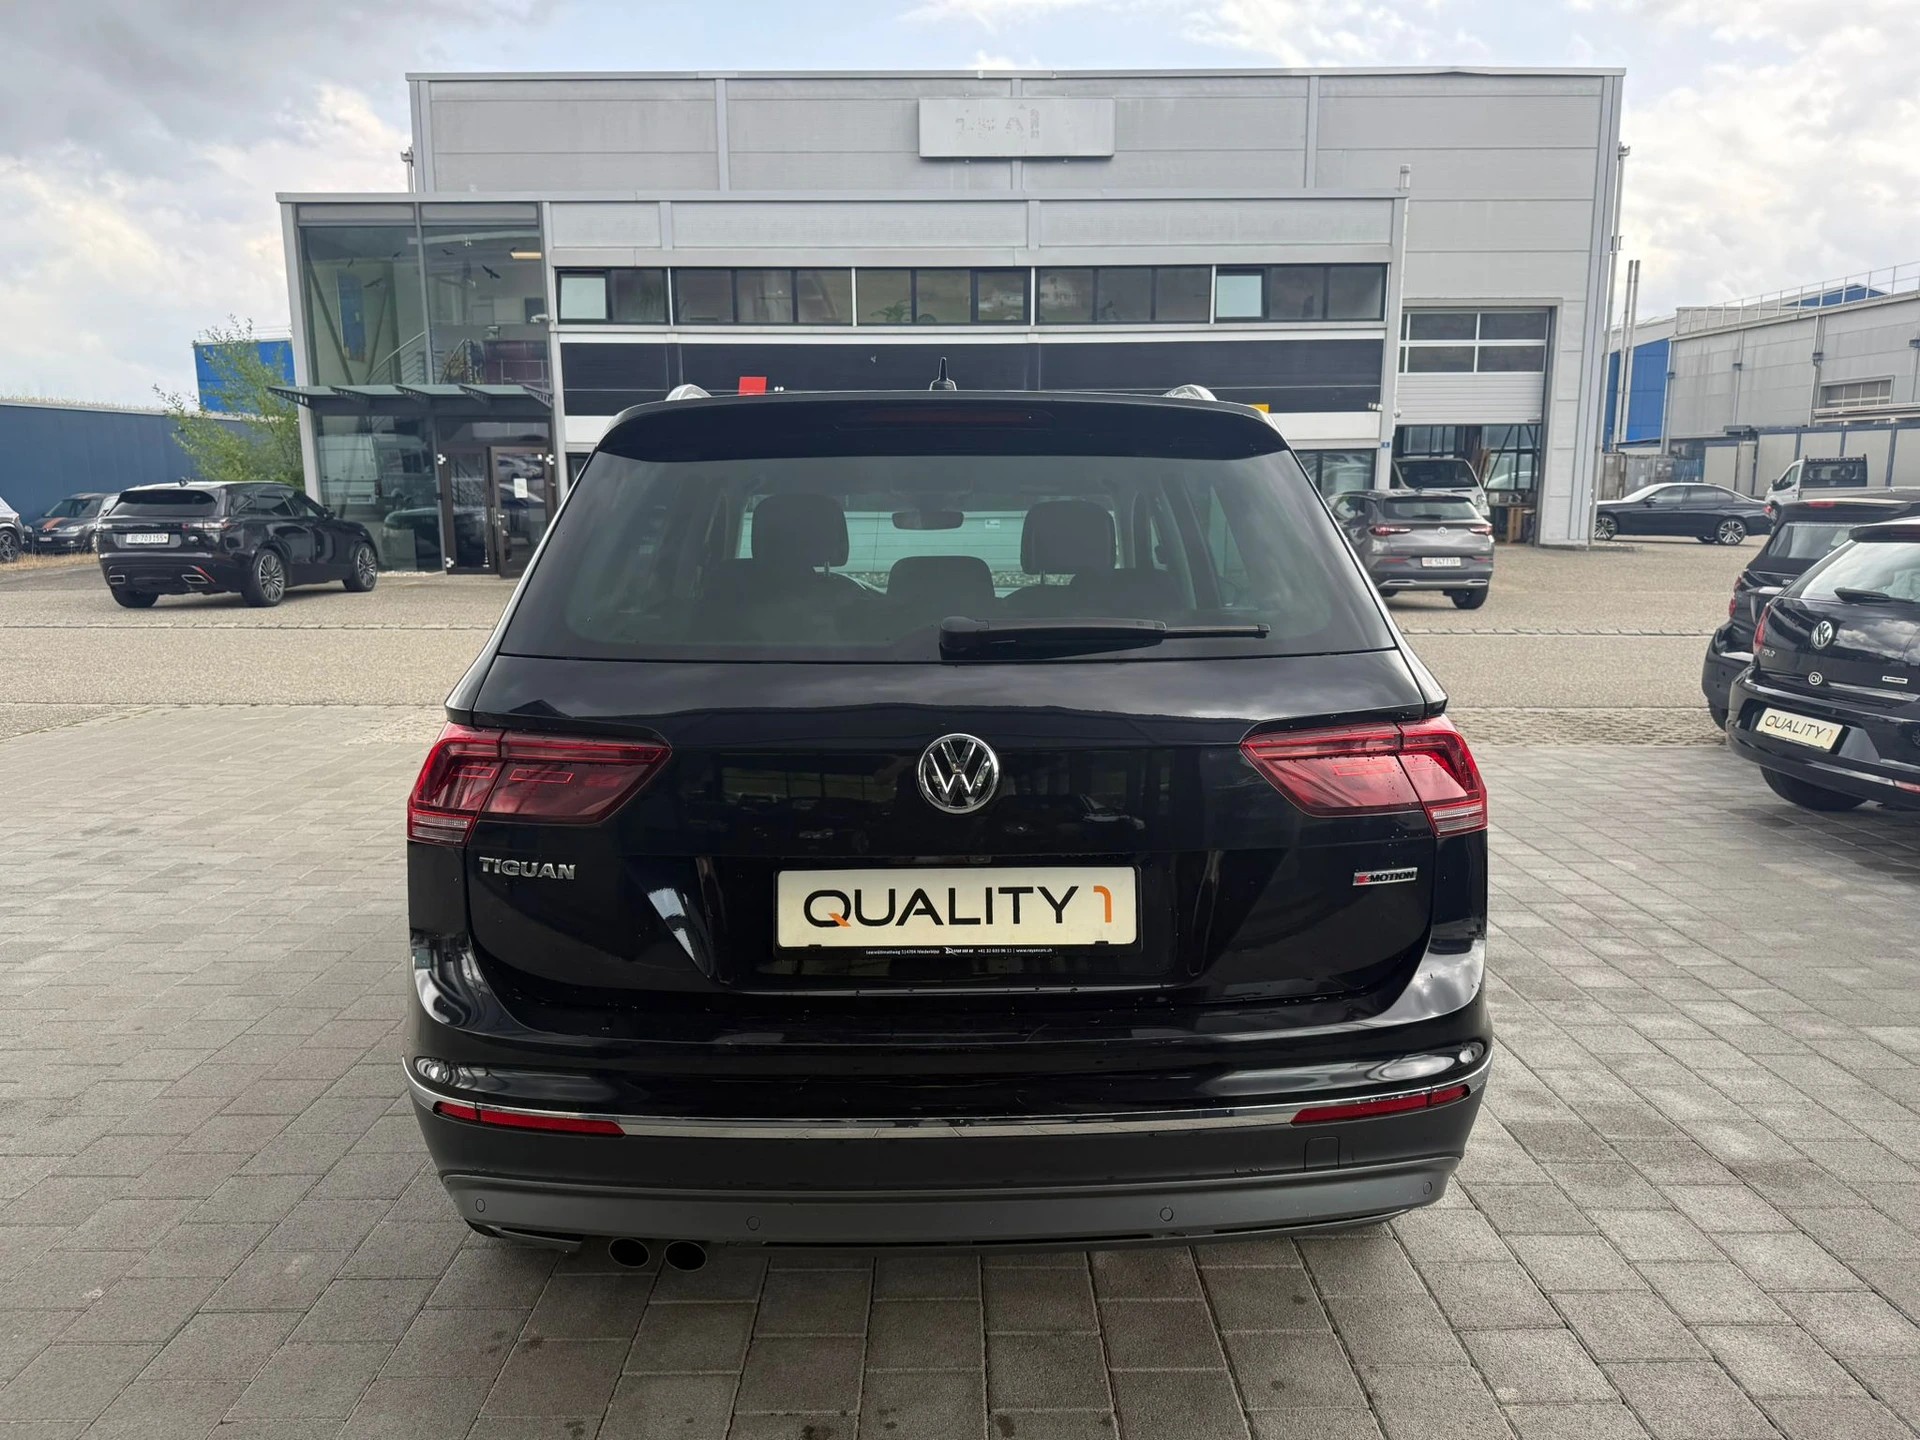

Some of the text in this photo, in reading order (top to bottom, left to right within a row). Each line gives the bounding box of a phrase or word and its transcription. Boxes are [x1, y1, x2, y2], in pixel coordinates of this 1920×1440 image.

[1765, 715, 1826, 739] QUALITY
[479, 856, 576, 880] TIGUAN
[804, 885, 1112, 927] QUALITY 1
